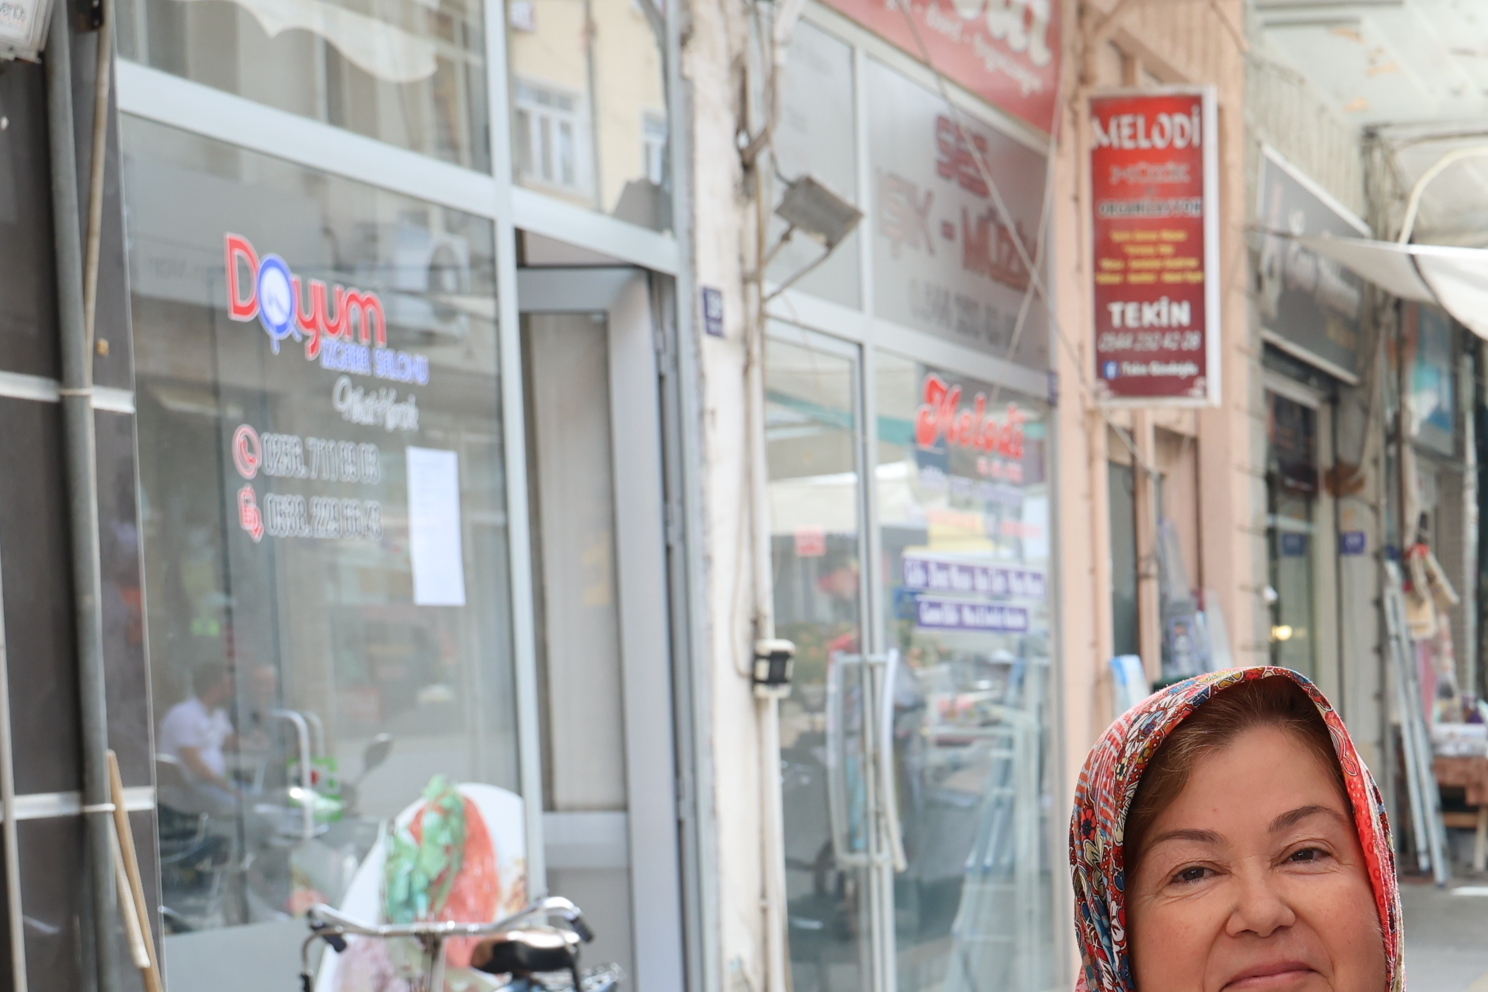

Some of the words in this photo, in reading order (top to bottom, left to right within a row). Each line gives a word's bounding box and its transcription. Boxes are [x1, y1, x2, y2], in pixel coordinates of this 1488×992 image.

[1091, 105, 1202, 151] MELODİ
[224, 231, 387, 360] Doyum
[1108, 296, 1191, 328] TEKİN
[916, 373, 1025, 460] Melodi
